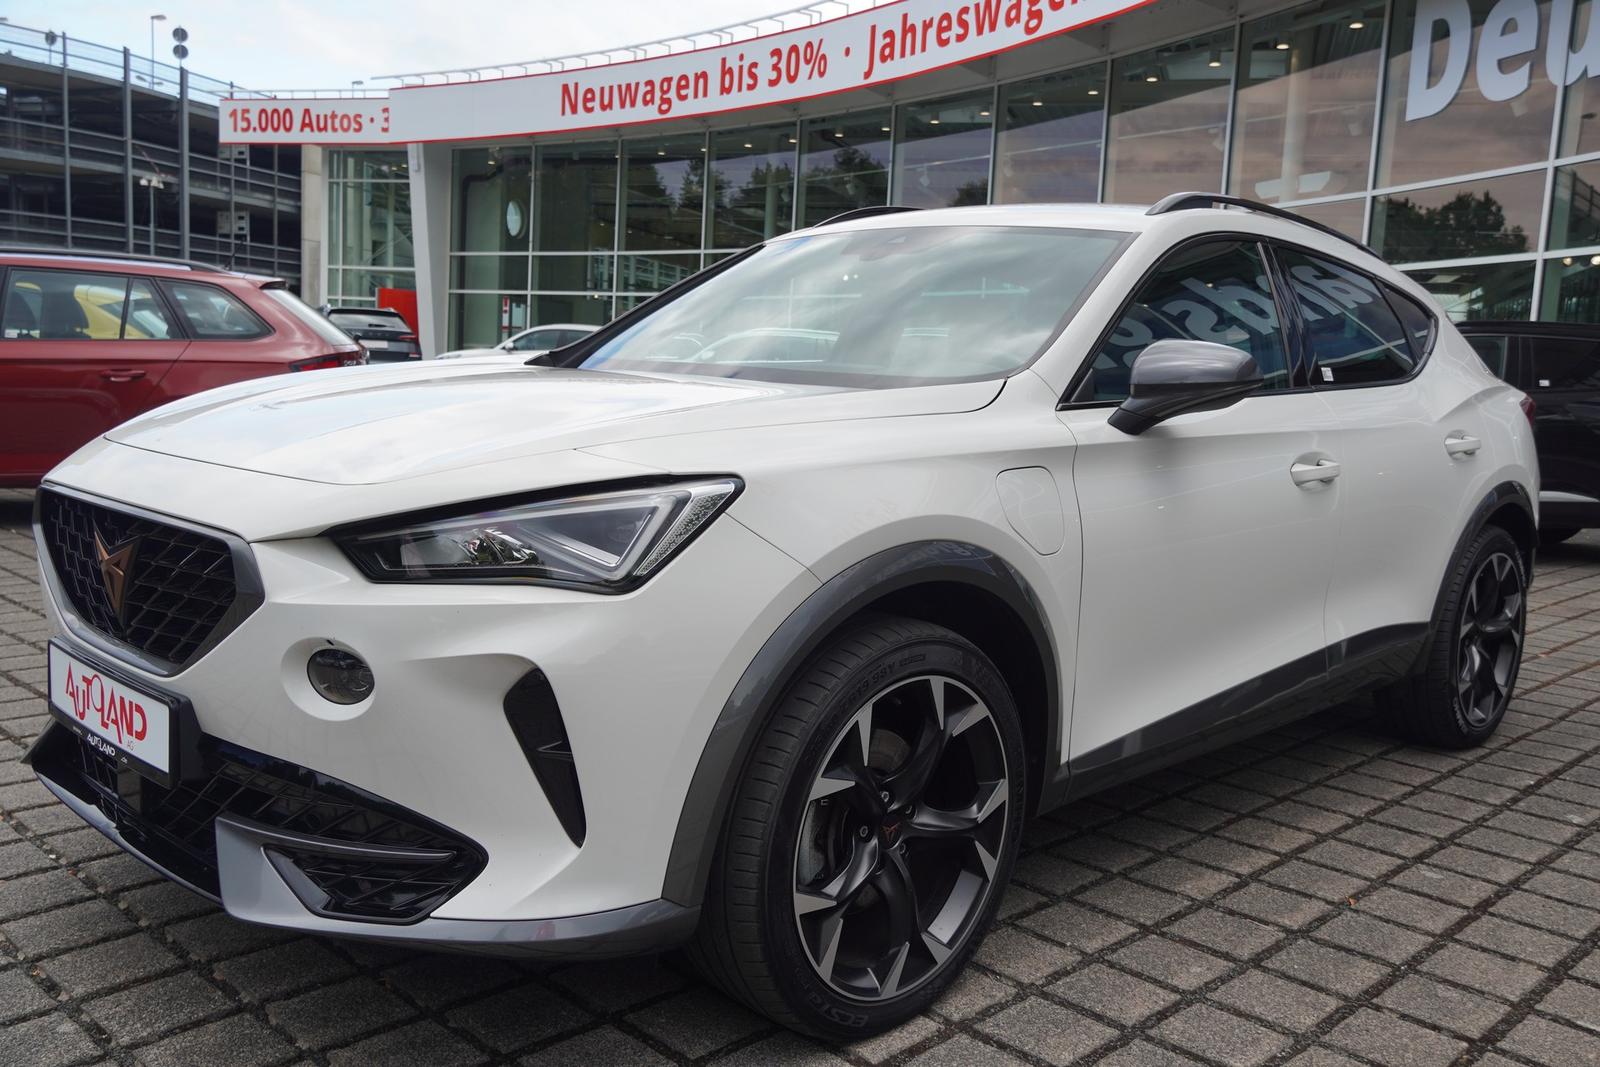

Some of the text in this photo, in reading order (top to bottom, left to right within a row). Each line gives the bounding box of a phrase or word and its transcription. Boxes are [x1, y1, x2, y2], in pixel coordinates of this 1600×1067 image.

[561, 0, 1085, 116] Neuwagen bis 30% Jahreswag
[228, 107, 294, 133] 15.000
[300, 107, 364, 133] Autos
[65, 662, 148, 744] AUTOLAND
[87, 733, 116, 757] AUTOLAND
